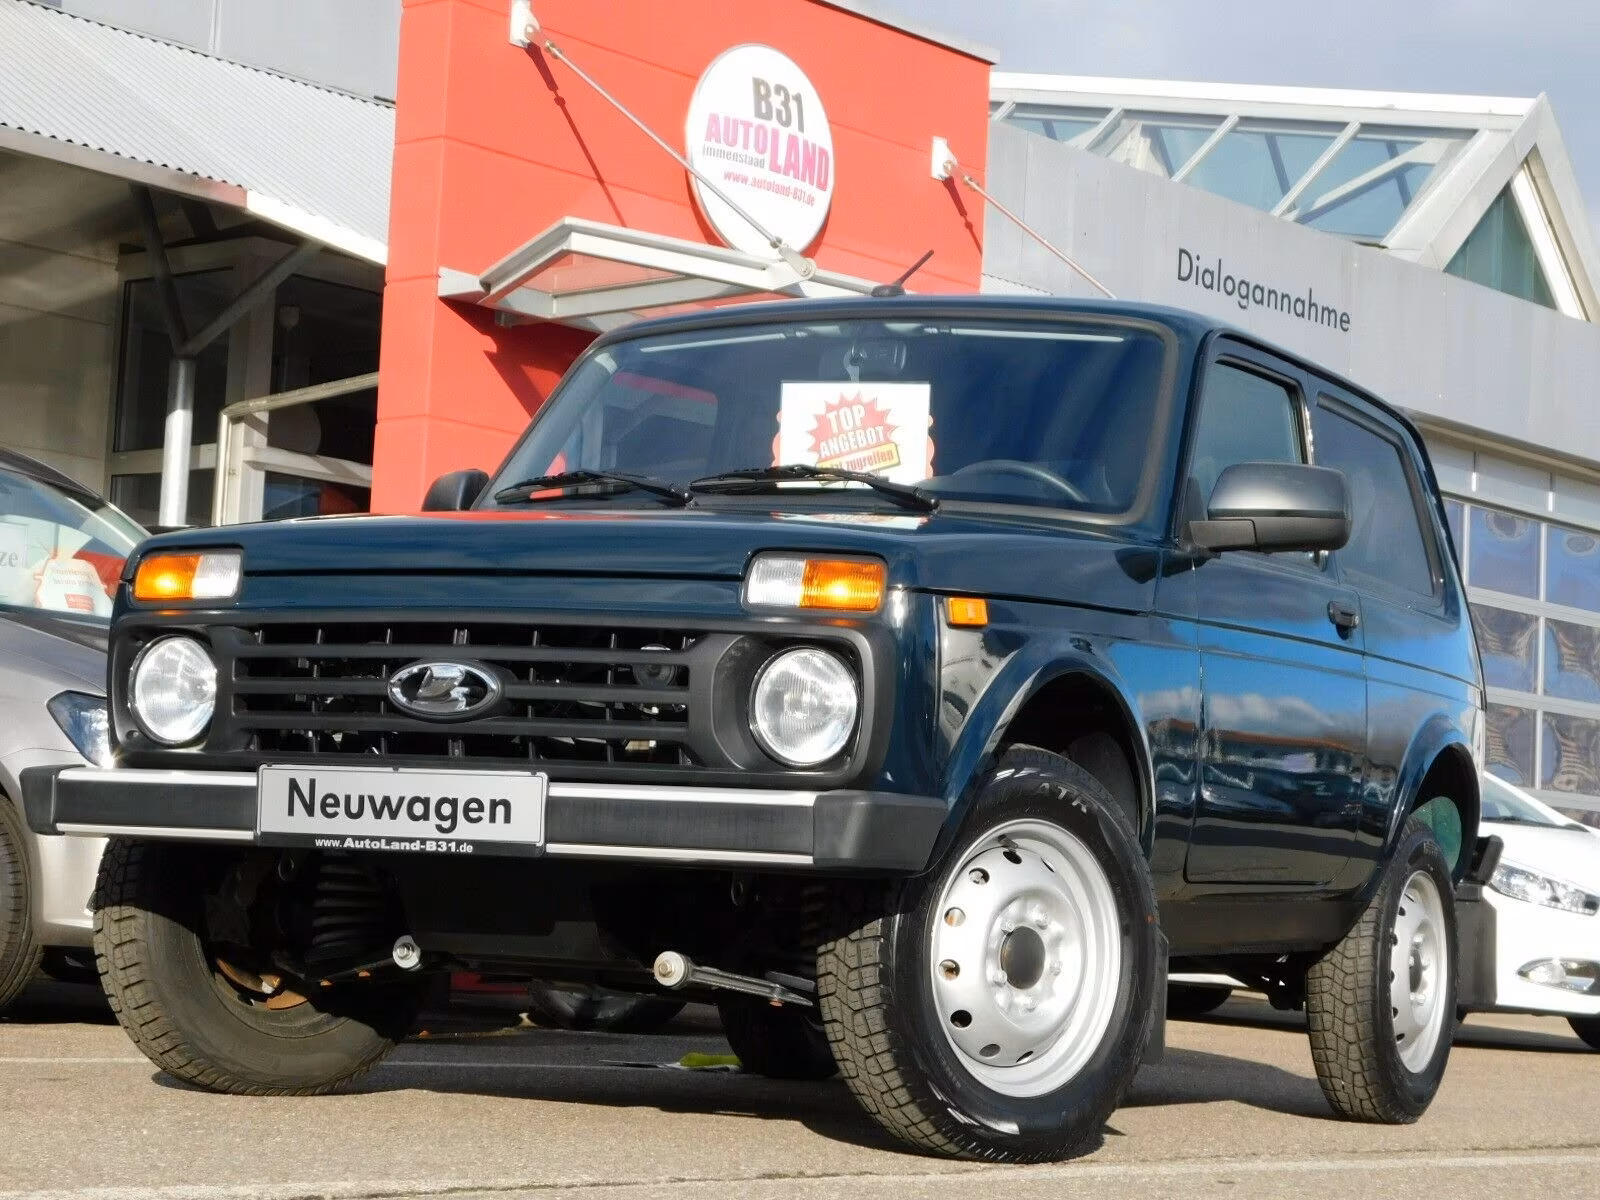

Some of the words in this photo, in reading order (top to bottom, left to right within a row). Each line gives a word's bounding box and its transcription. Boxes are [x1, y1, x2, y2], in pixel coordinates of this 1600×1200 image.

[752, 76, 805, 134] B31
[1177, 247, 1351, 332] Dialogannahme
[825, 403, 866, 435] TOP
[819, 425, 885, 459] ANGEBOT
[286, 777, 512, 834] Neuwagen
[314, 836, 474, 854] www.AutoLand-B31.de
